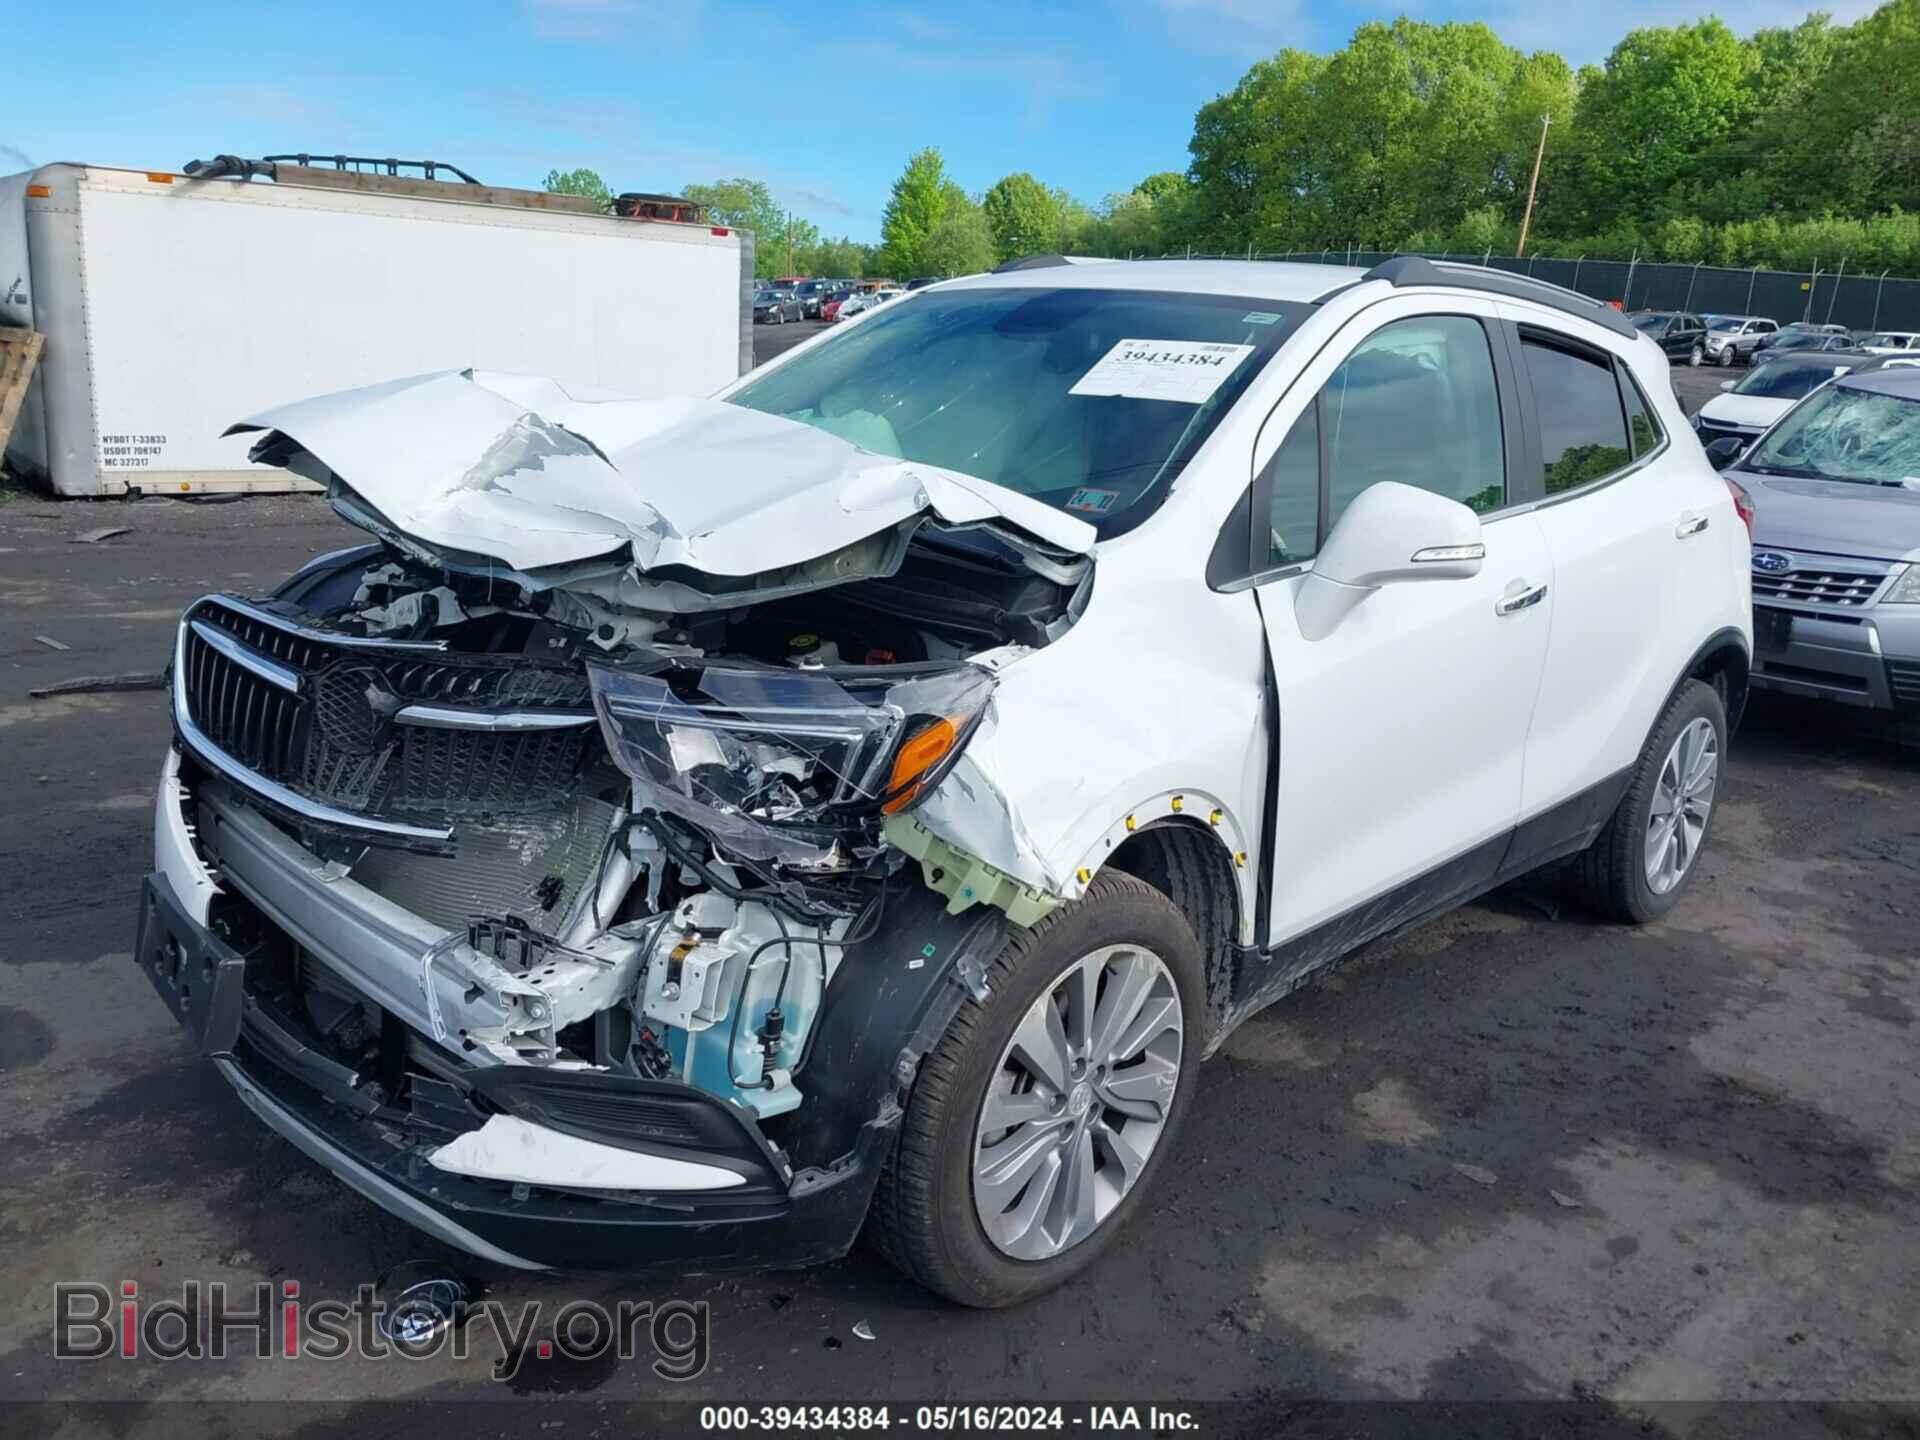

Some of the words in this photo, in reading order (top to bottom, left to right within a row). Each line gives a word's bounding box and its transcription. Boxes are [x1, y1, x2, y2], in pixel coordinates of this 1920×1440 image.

[1121, 350, 1226, 367] 39434384
[103, 447, 131, 455] USDOT
[104, 458, 118, 466] MC
